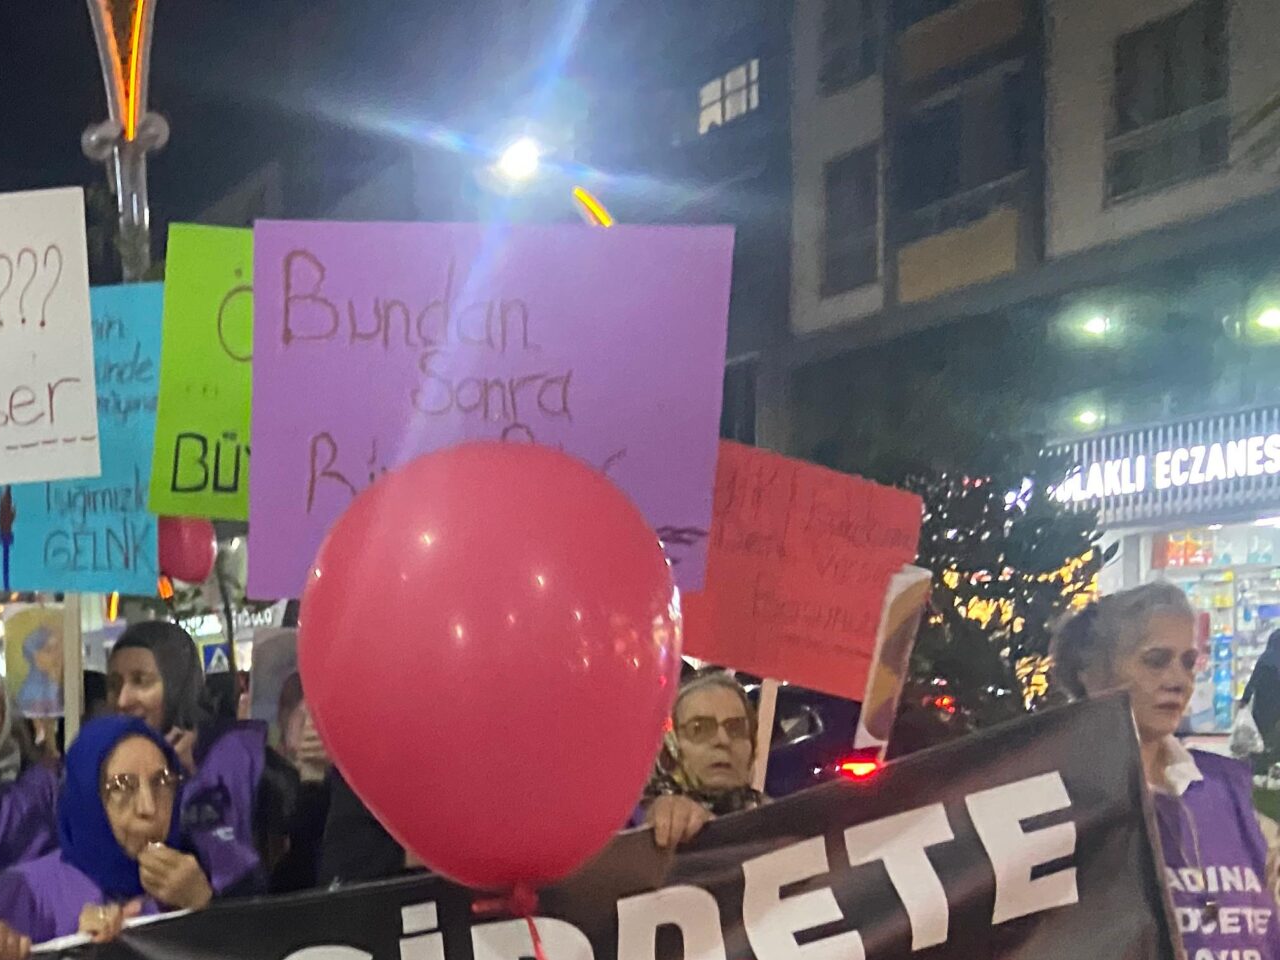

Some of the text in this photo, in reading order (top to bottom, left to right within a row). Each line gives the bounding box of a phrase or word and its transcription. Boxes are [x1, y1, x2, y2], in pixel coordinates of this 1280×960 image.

[282, 249, 542, 352] Bundan
[410, 351, 575, 425] Sonra
[172, 430, 251, 493] BÜ
